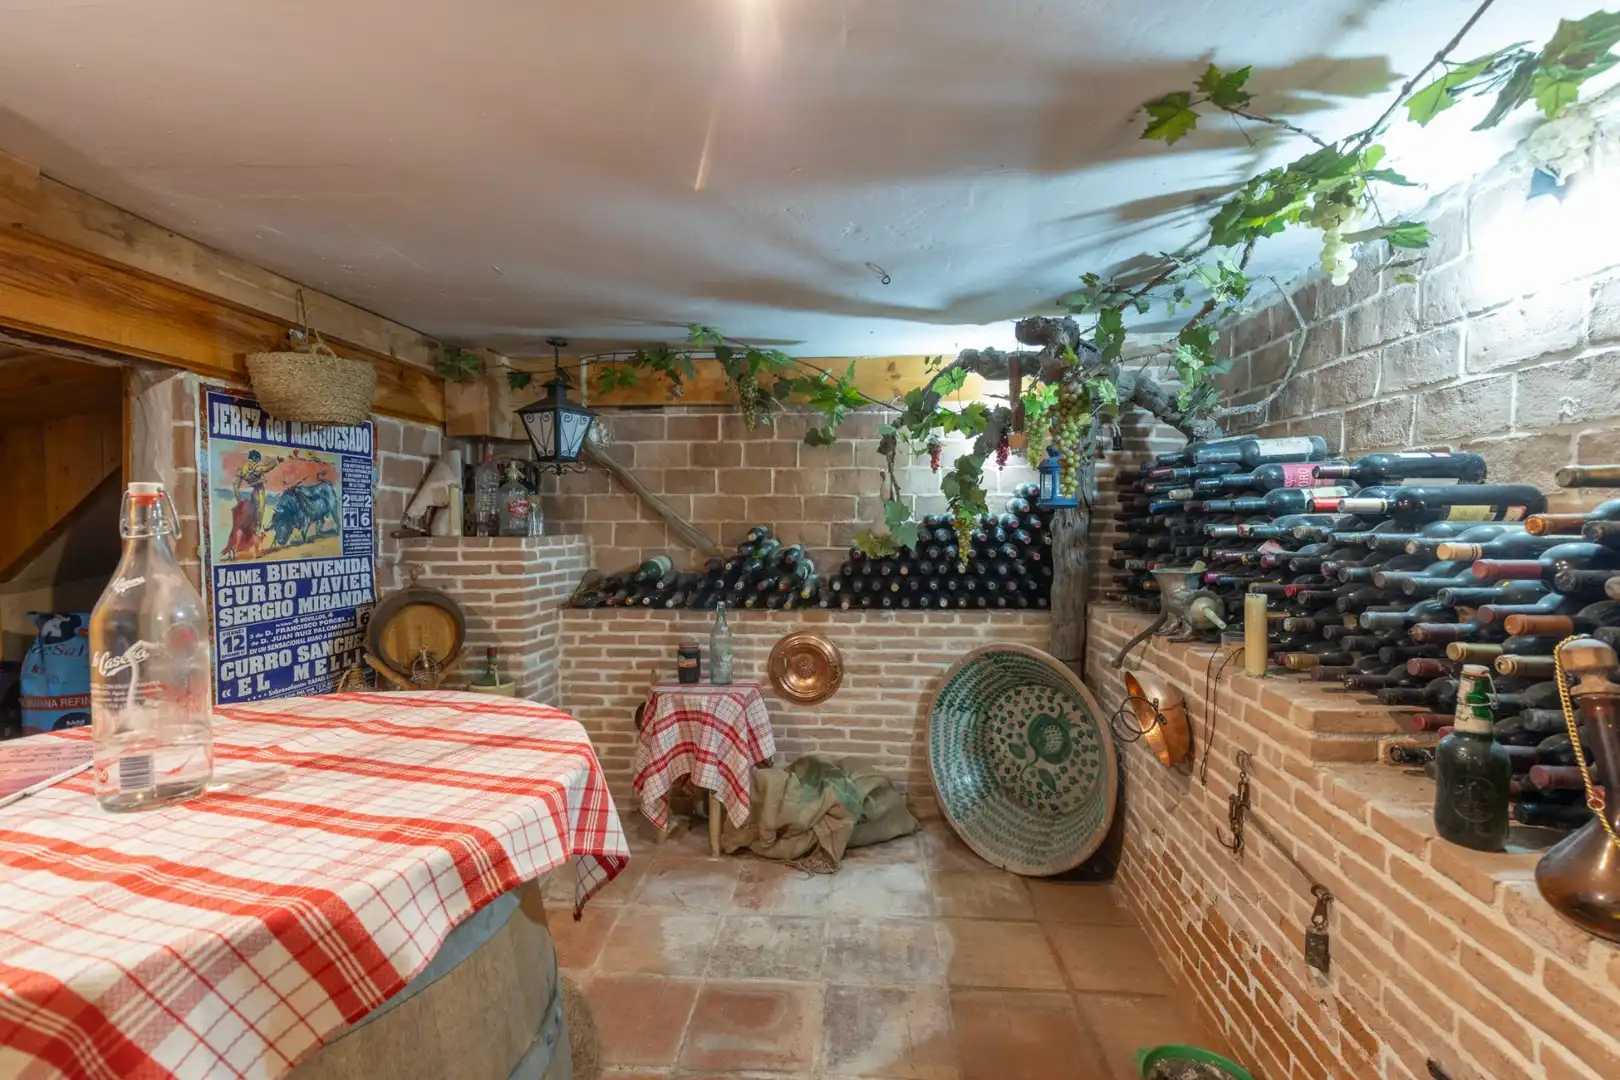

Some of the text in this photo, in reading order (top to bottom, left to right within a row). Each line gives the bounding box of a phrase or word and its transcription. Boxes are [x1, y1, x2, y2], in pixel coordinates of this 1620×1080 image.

[213, 402, 370, 453] JEREZ del MARQUESADO
[343, 494, 350, 506] 2
[365, 495, 371, 507] 2
[344, 513, 357, 527] 11
[361, 513, 370, 526] 6
[217, 557, 370, 587] JAIME BIENVENIDA
[218, 573, 371, 607] CURRO JAVIER
[218, 589, 373, 627] SERGIO MIRANDA
[275, 622, 317, 634] FRANCISCO
[319, 616, 346, 626] PORCEL
[222, 634, 245, 653] 12
[271, 633, 293, 643] JUAN
[295, 629, 312, 638] RUIZ
[220, 633, 365, 682] CURRO SANCHE
[237, 673, 270, 697] EL
